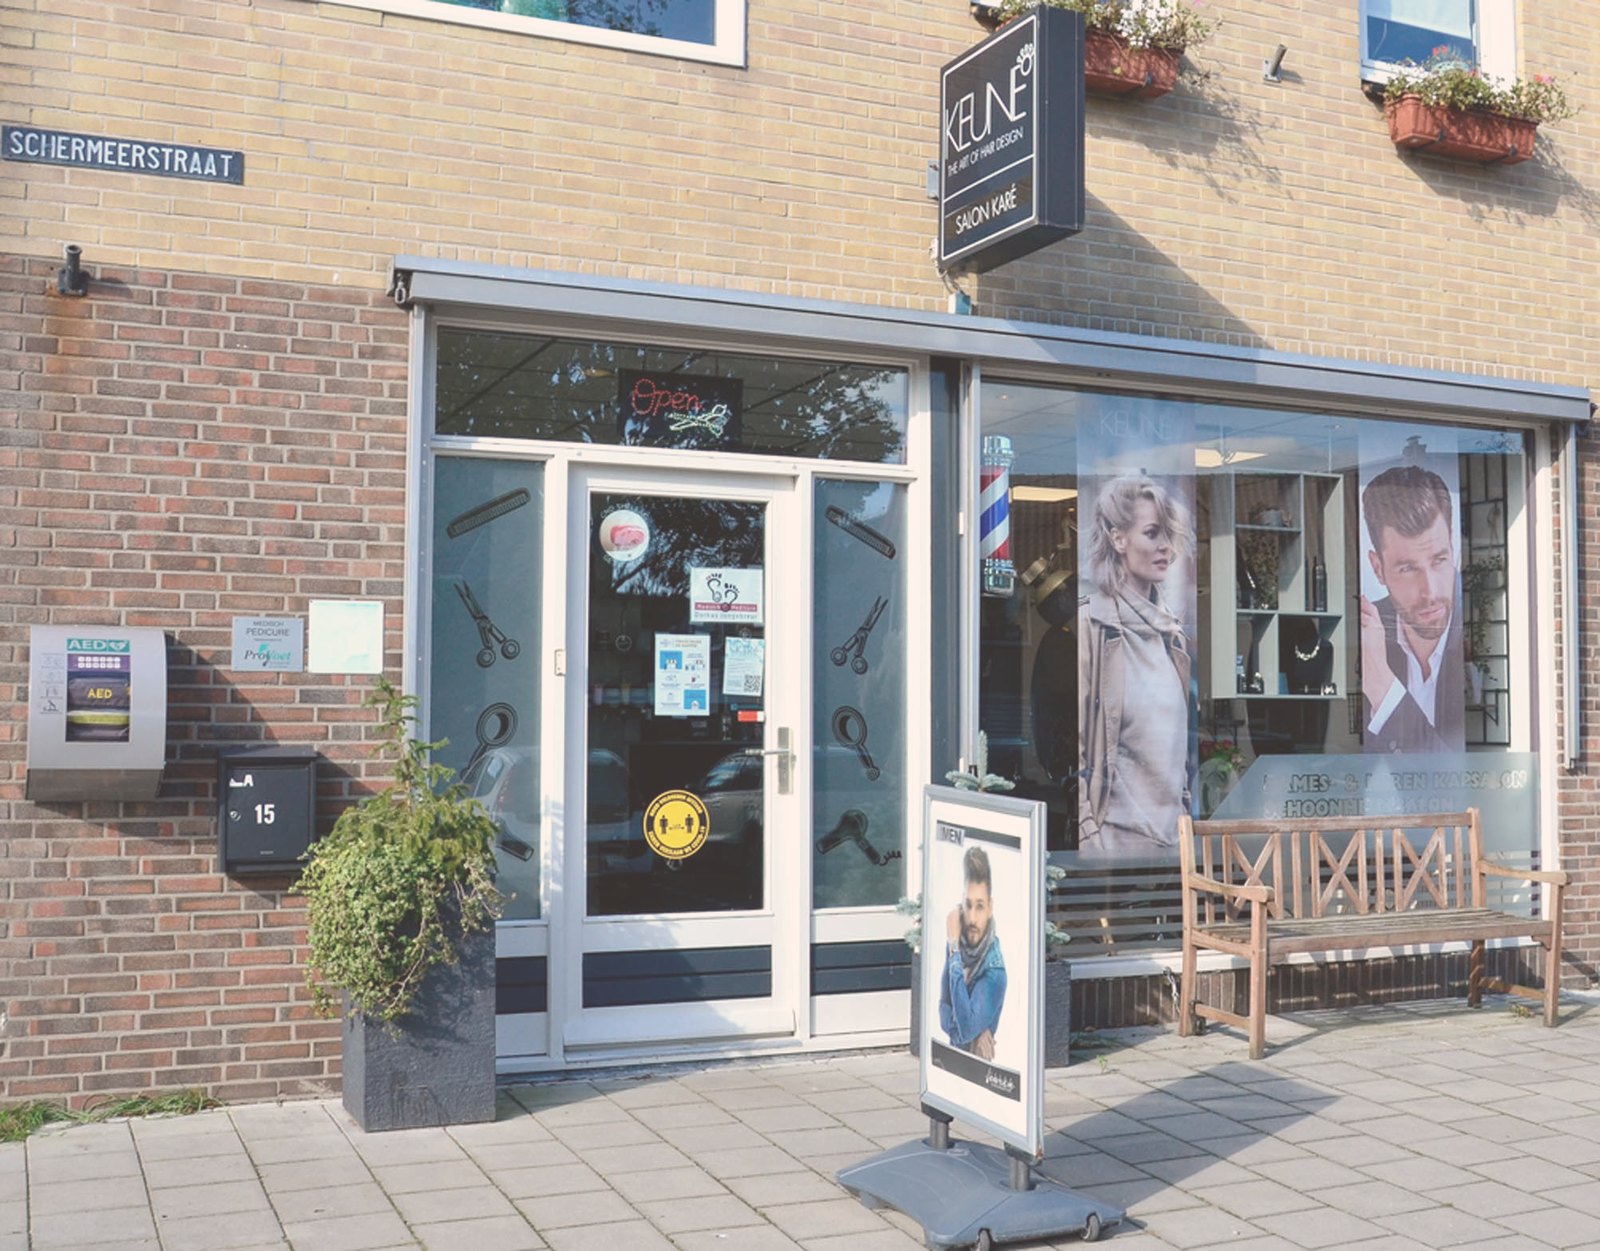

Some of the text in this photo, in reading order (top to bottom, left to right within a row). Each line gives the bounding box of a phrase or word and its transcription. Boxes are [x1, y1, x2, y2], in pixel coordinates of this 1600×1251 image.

[945, 65, 1027, 152] KEUNE
[9, 130, 233, 178] SCHERMEERSTRAAT
[947, 126, 1024, 178] THE ART OF HAIR DESIGN
[955, 182, 1018, 235] SALON KARÉ
[631, 378, 703, 417] Open
[246, 628, 291, 637] PEDICURE
[68, 639, 108, 650] AED
[87, 687, 113, 699] AED
[1434, 770, 1528, 790] KAPSAON
[254, 803, 276, 825] 15
[942, 825, 962, 847] MEN
